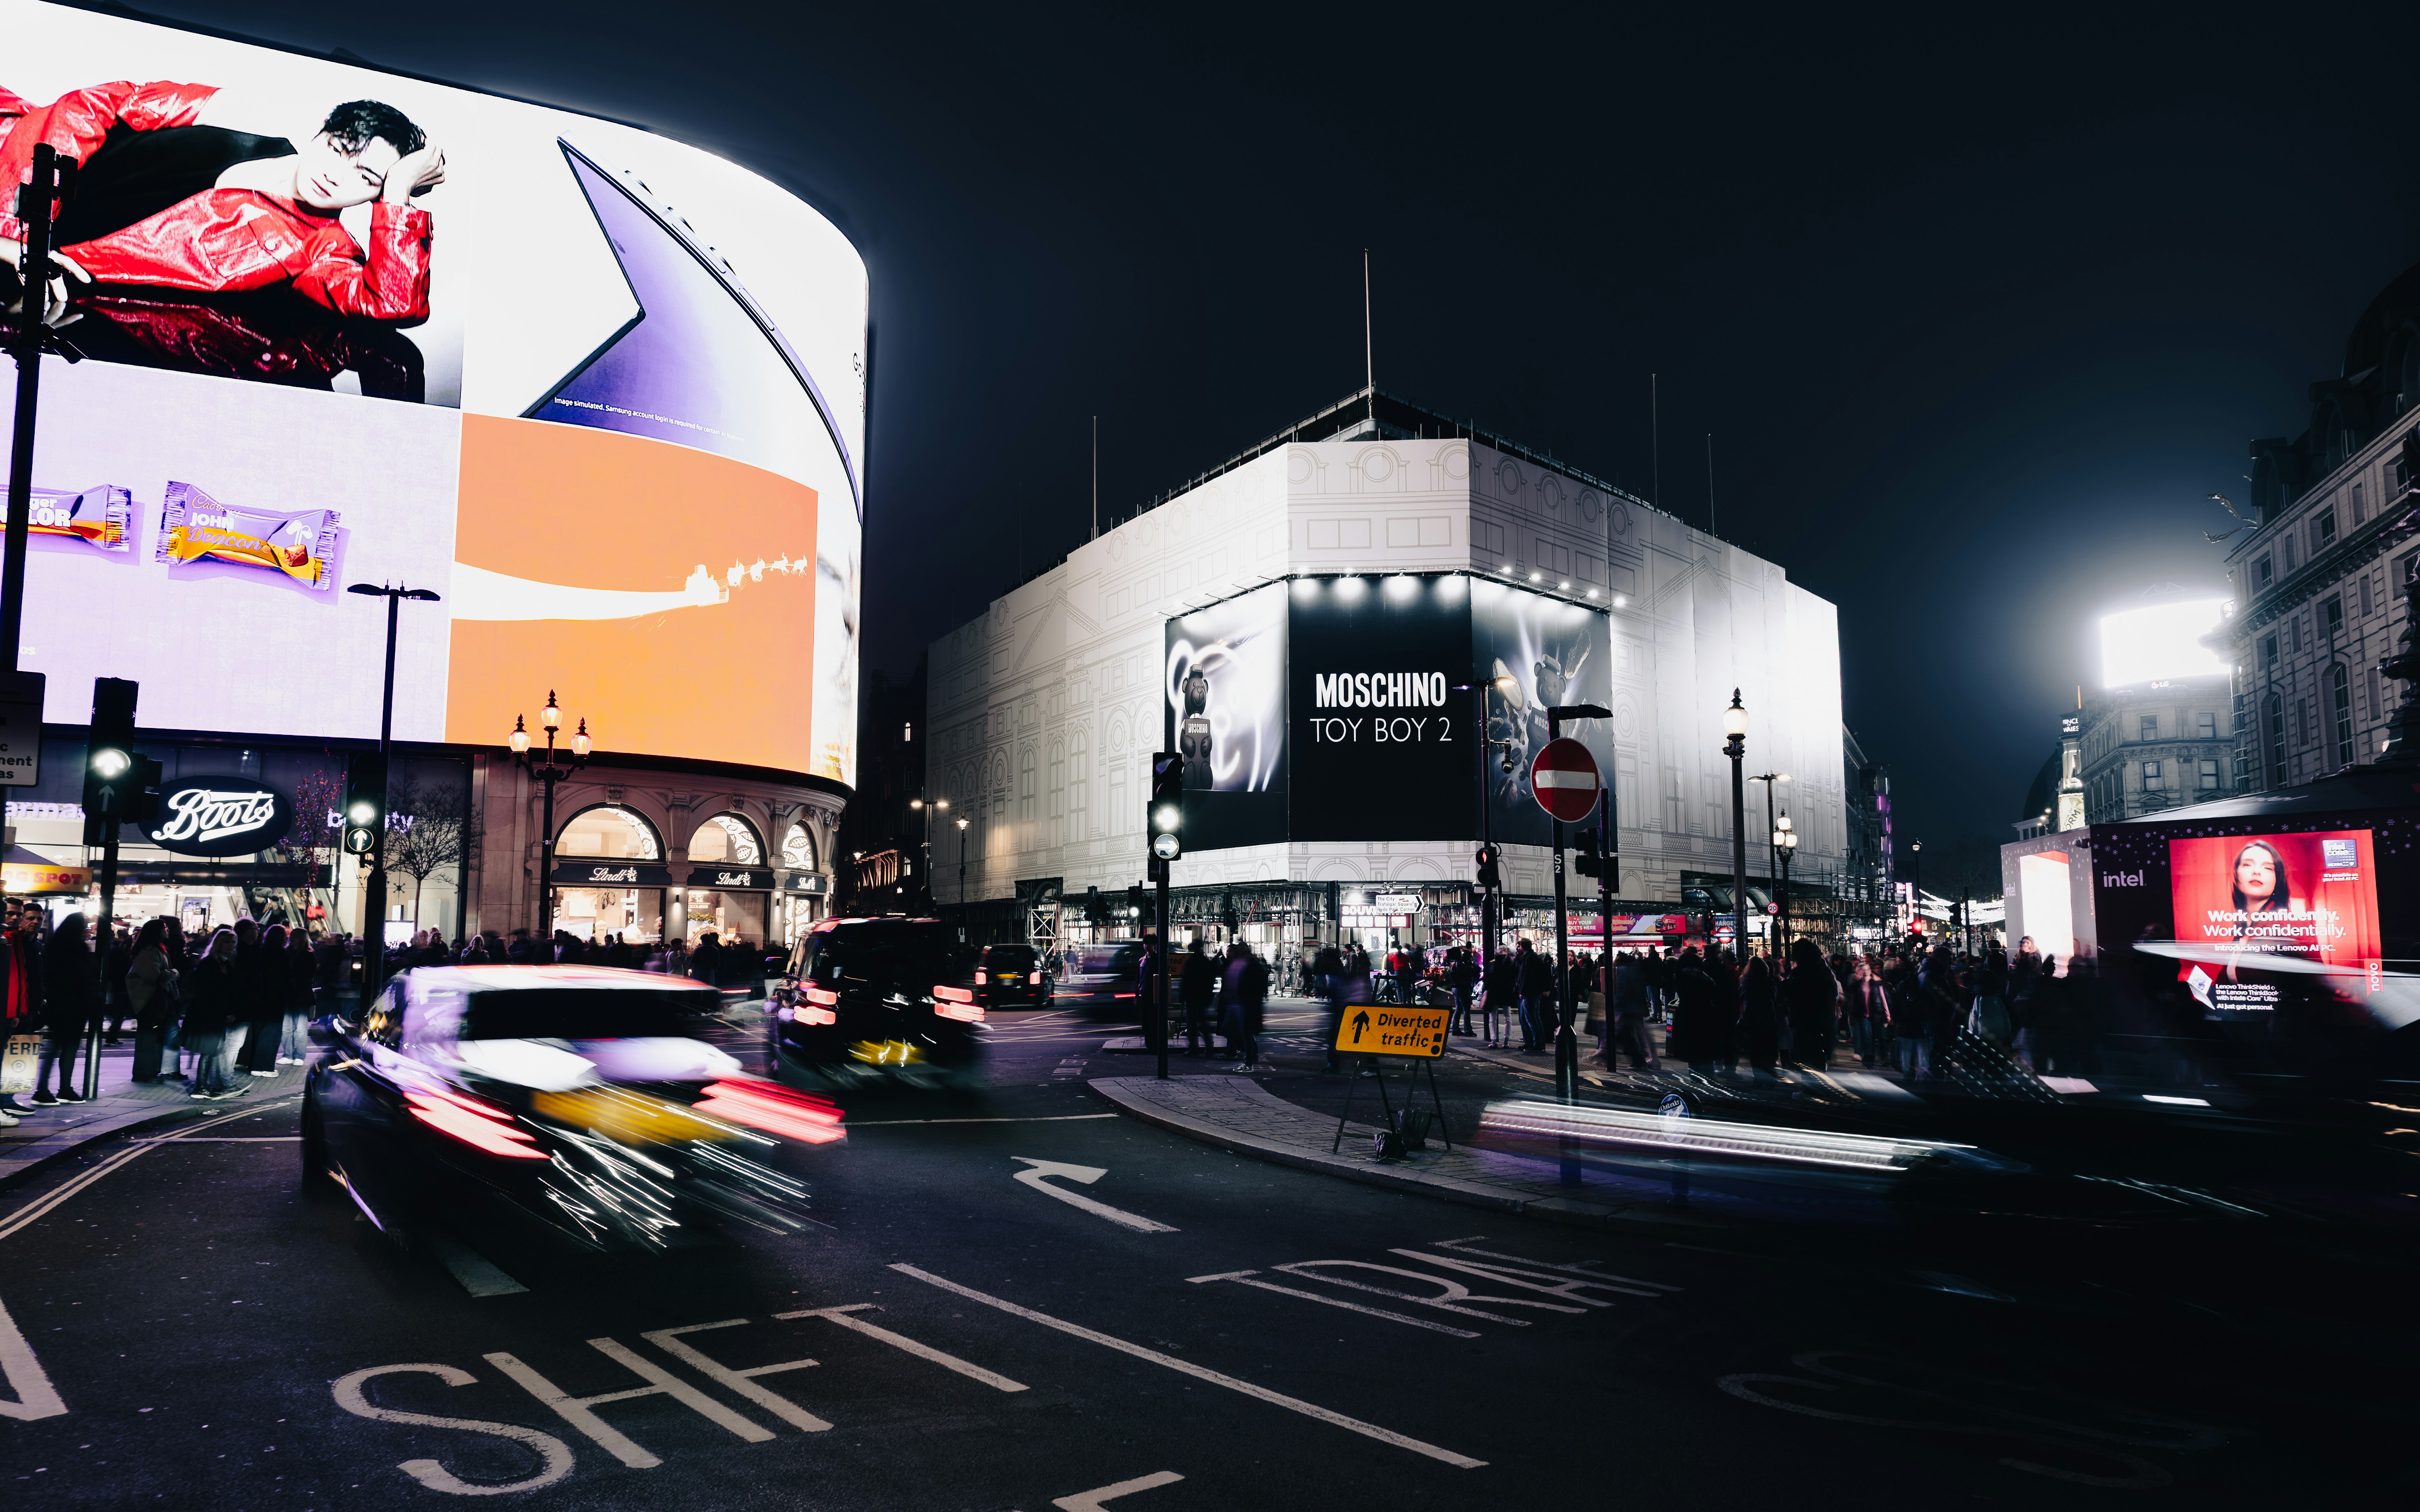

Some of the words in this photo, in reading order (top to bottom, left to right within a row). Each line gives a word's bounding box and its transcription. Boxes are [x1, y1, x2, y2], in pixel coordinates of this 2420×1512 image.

[555, 397, 573, 407] Image
[574, 400, 604, 411] simulated.
[605, 405, 632, 416] Samsung
[632, 410, 654, 420] account
[655, 414, 668, 423] login
[674, 420, 696, 429] required
[703, 427, 720, 435] certain
[190, 512, 235, 530] JOHN
[186, 526, 263, 551] Deacon
[1316, 672, 1446, 707] MOSCHINO
[1188, 723, 1208, 734] MOSCHINO
[1310, 718, 1363, 742] TOY
[1375, 718, 1427, 742] BOY
[1438, 717, 1452, 741] 2
[152, 789, 274, 842] Boots
[33, 872, 82, 885] SPOT
[589, 868, 627, 881] Lindt
[715, 872, 743, 886] Lindt
[2005, 882, 2016, 897] intel
[2207, 910, 2248, 922] Work
[2251, 908, 2339, 923] confidently.
[2203, 924, 2243, 937] Work
[2245, 924, 2346, 938] confidentially.
[2370, 962, 2380, 991] novo
[1378, 1013, 1442, 1029] Diverted
[1382, 1032, 1429, 1047] traffic
